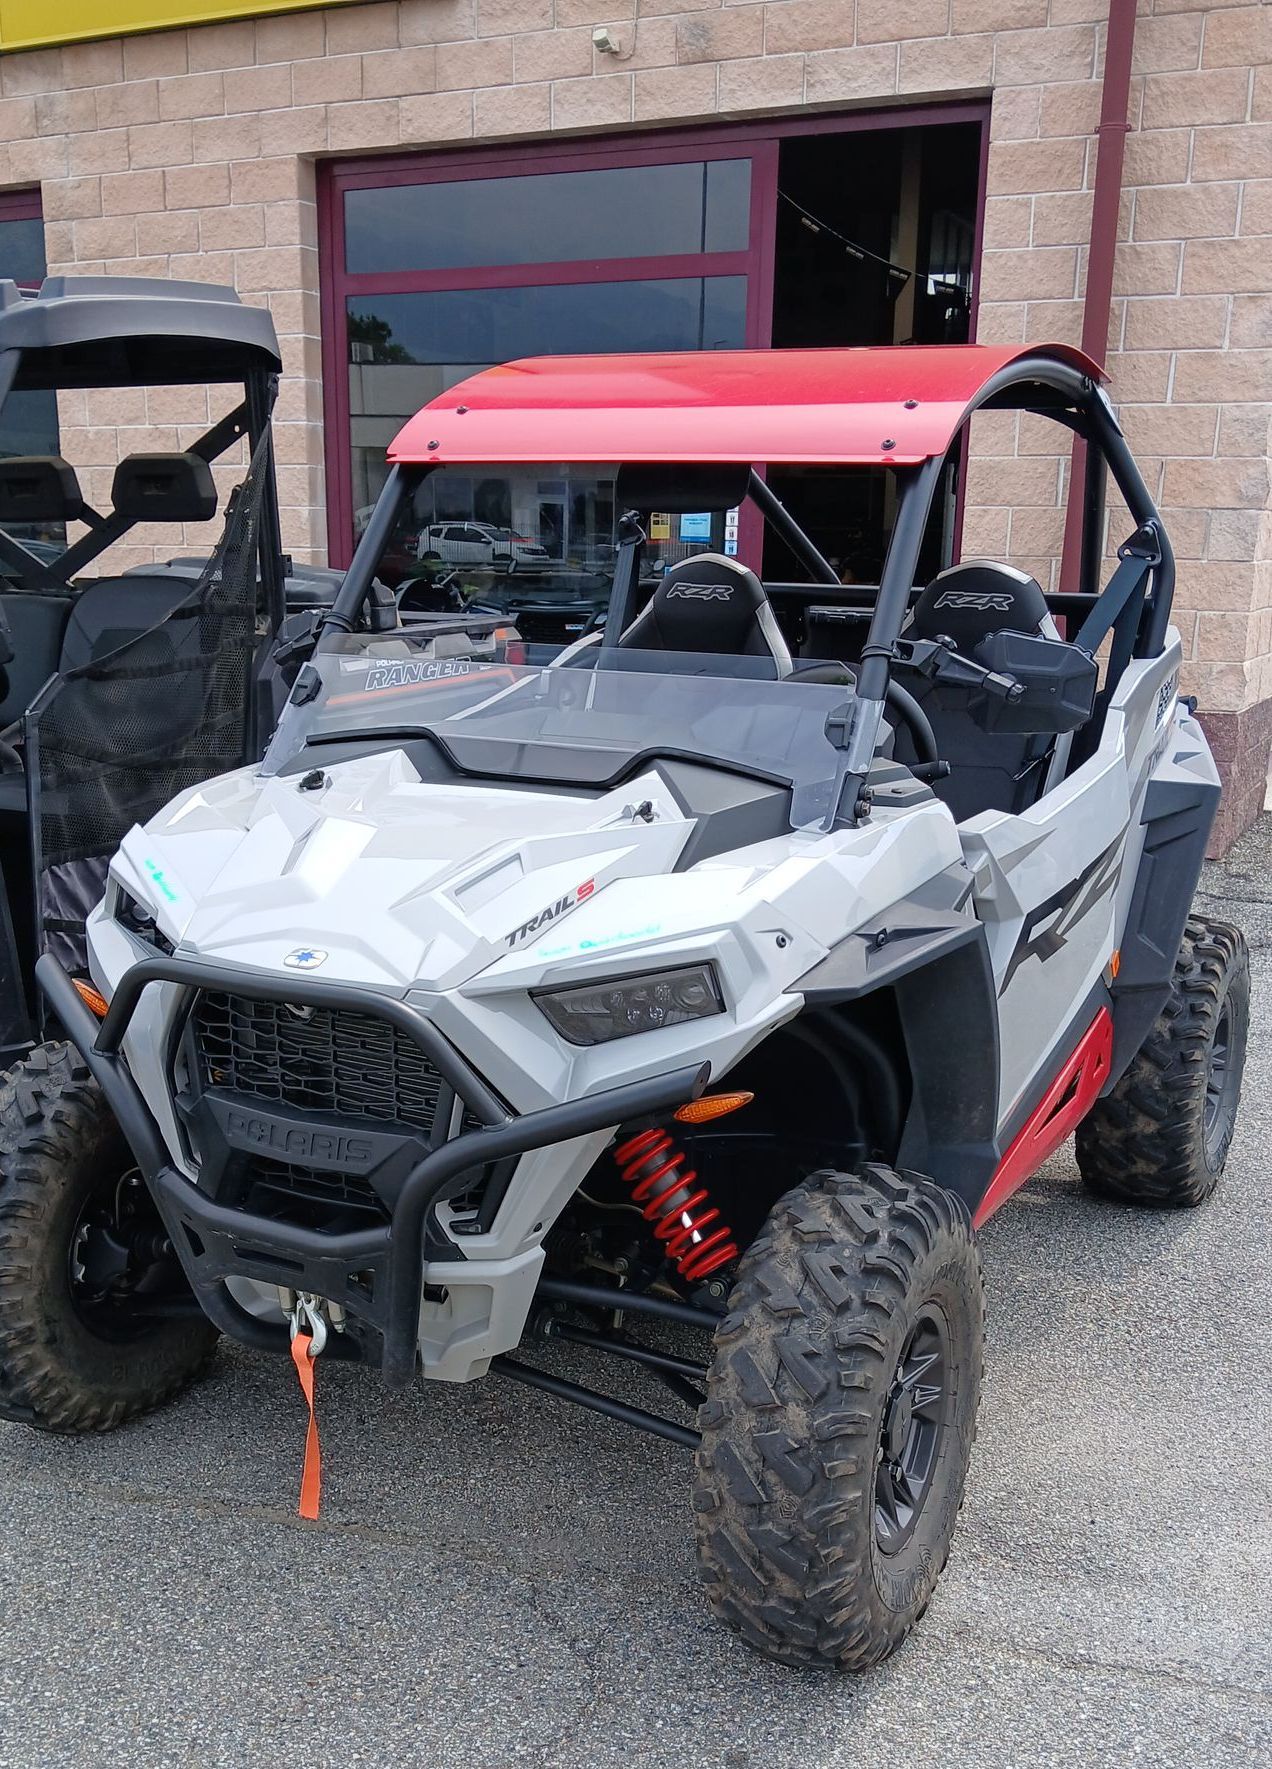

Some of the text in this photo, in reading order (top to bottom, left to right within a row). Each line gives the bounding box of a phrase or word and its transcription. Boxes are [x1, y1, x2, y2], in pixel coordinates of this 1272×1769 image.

[666, 582, 734, 600] RZR
[934, 591, 1015, 611] RZR
[365, 656, 471, 691] RANGER
[226, 1112, 374, 1165] POLARIS
